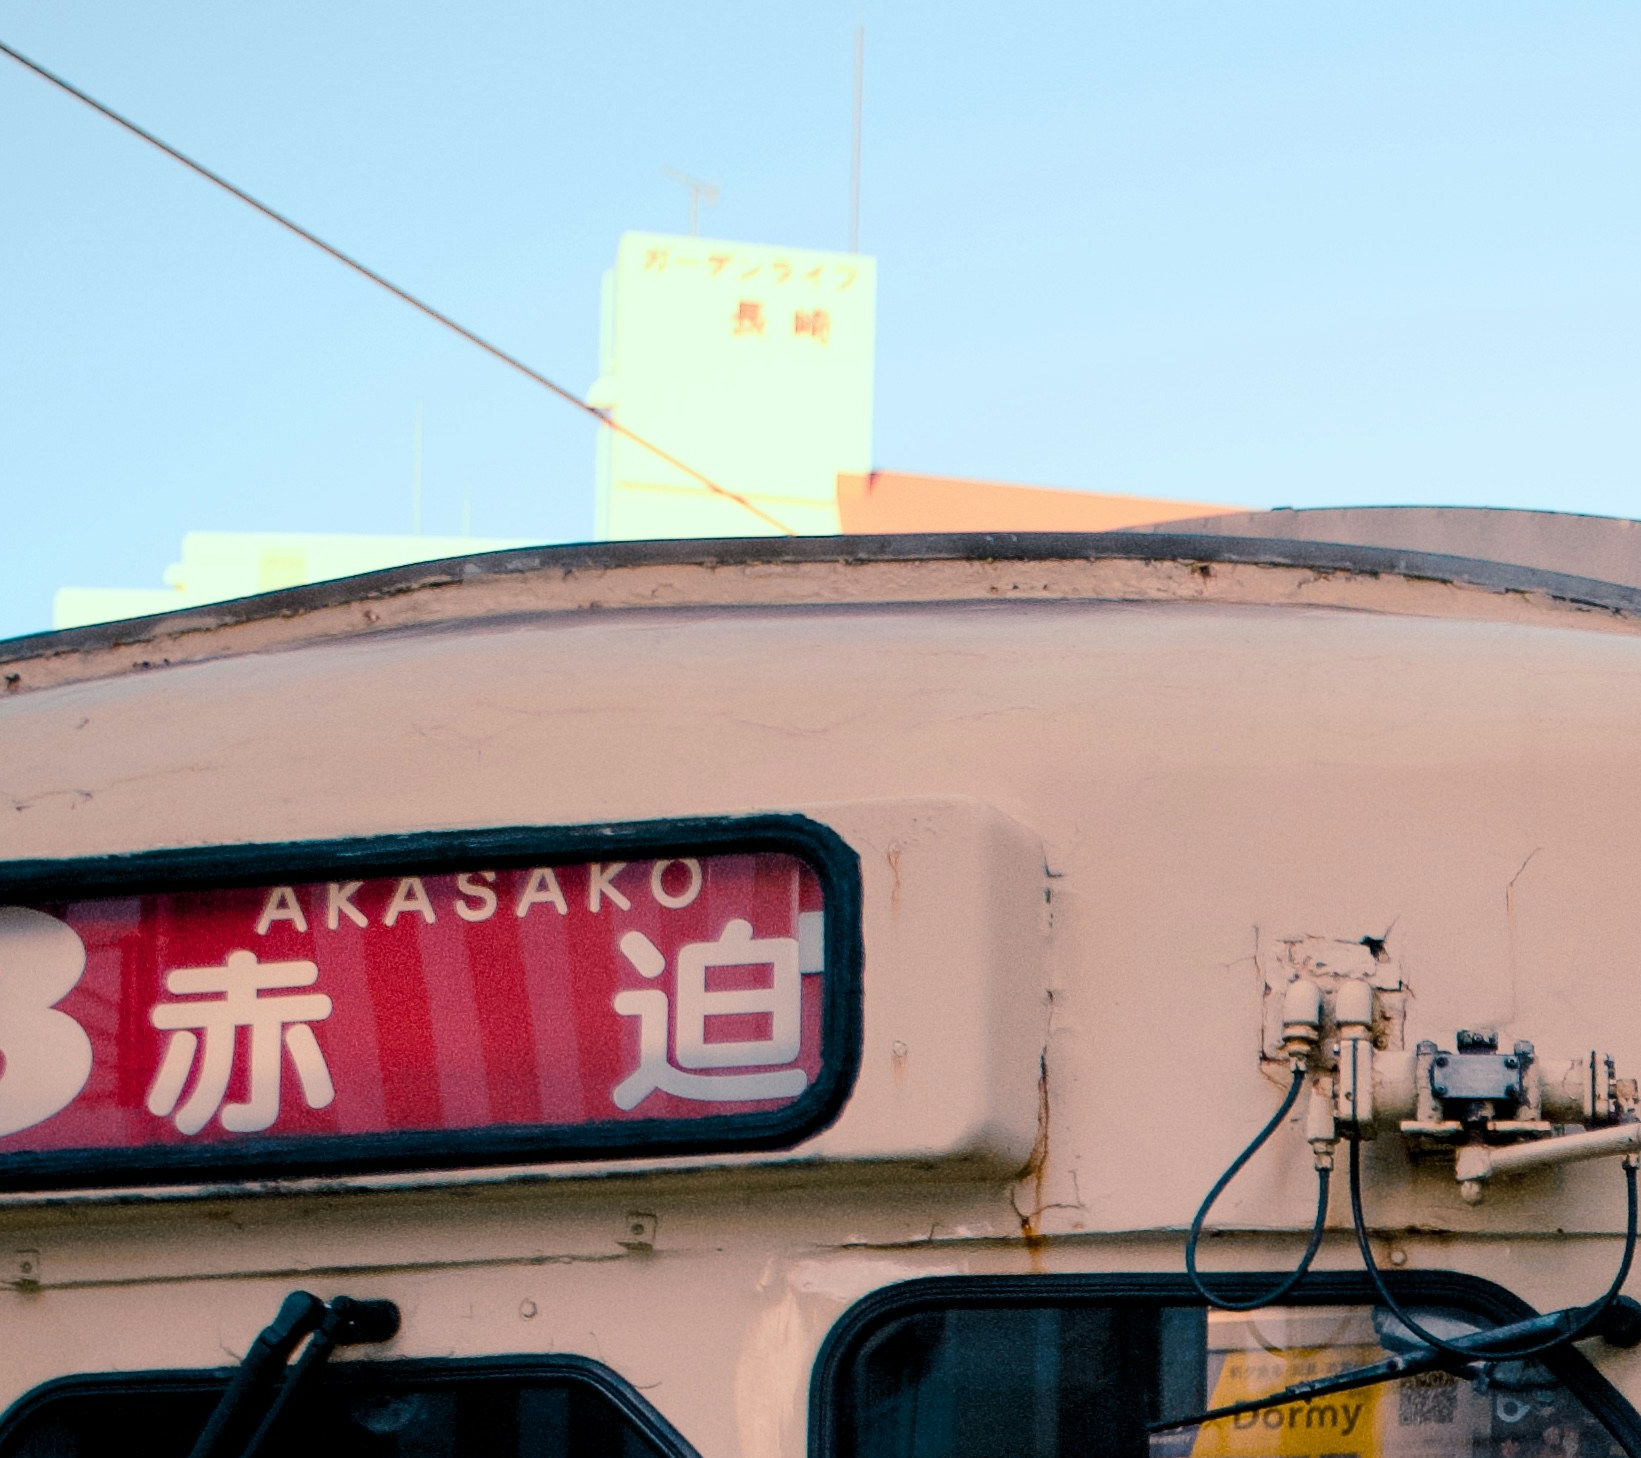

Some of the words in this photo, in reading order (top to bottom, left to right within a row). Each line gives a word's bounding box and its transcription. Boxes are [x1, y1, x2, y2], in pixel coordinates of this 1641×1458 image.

[733, 300, 831, 345] 長崎
[257, 858, 703, 936] AKASAKO
[1232, 1399, 1364, 1436] Dormy
